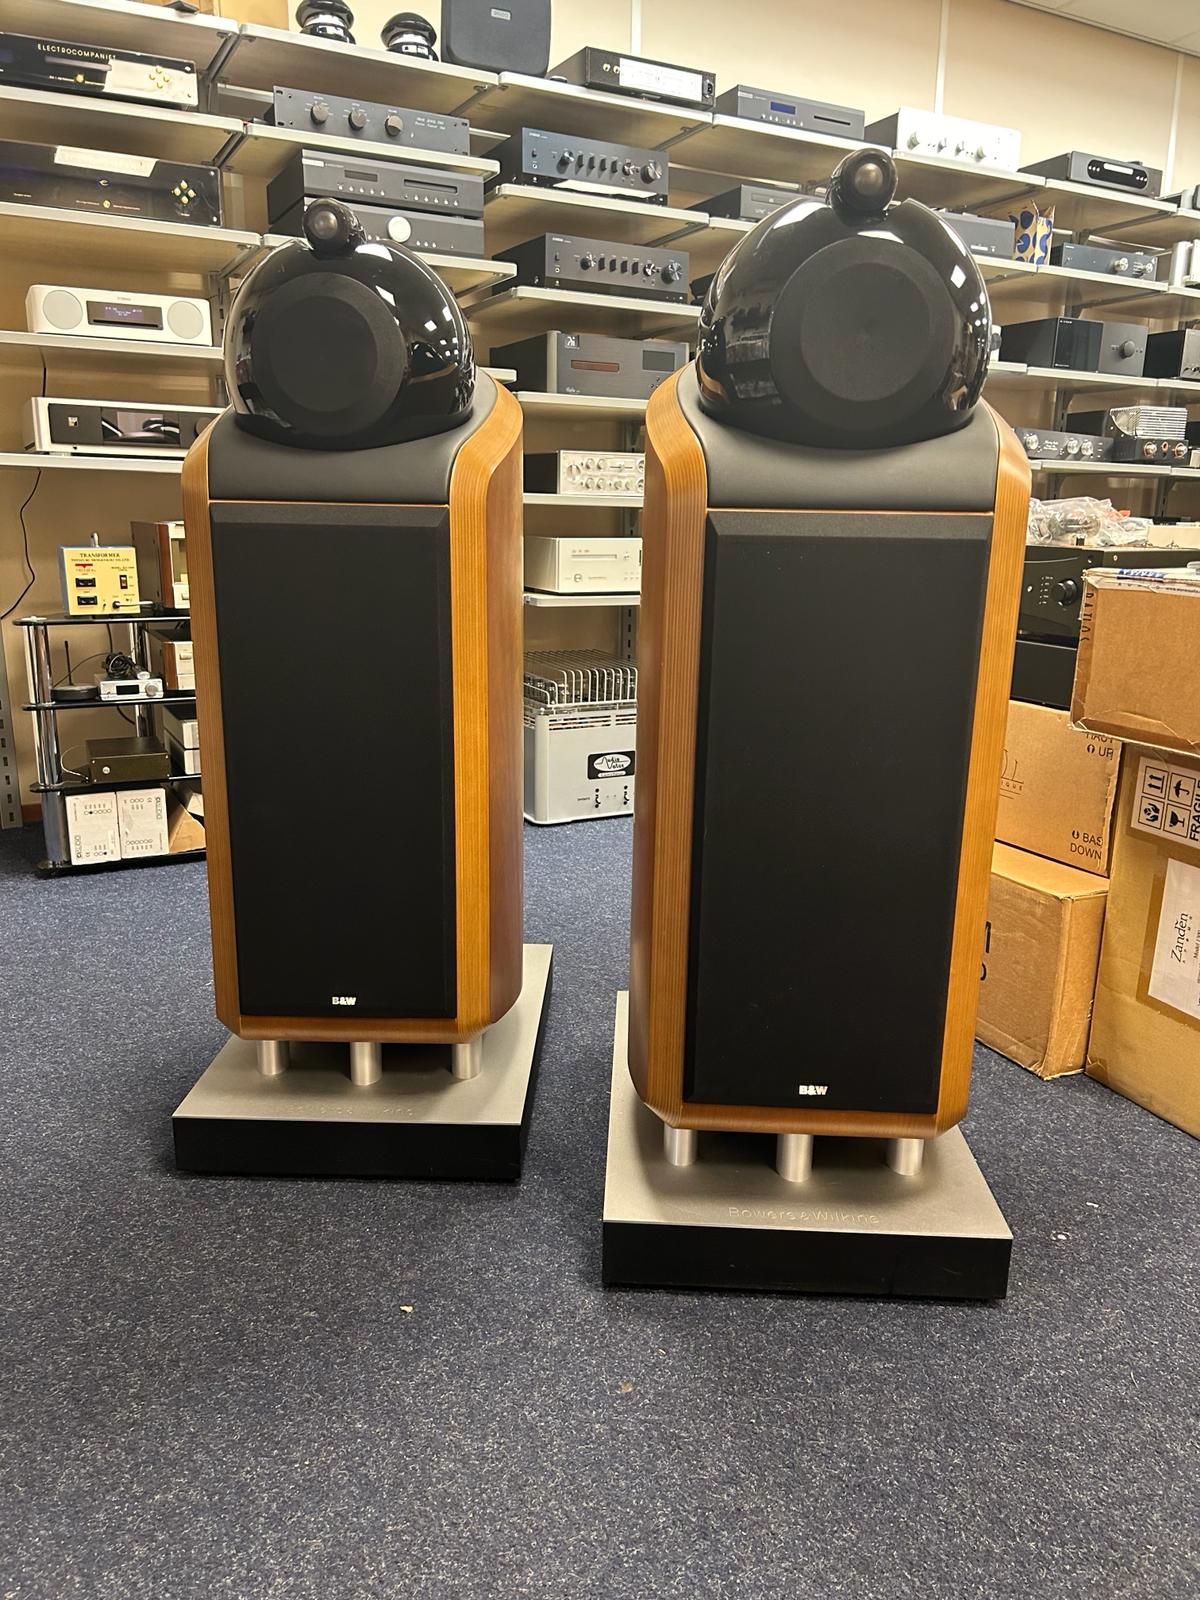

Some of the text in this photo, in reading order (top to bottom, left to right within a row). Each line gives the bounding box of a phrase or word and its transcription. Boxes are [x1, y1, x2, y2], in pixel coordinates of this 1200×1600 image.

[1070, 842, 1103, 860] DOWN
[331, 996, 357, 1006] B&W
[799, 1084, 828, 1096] B&W
